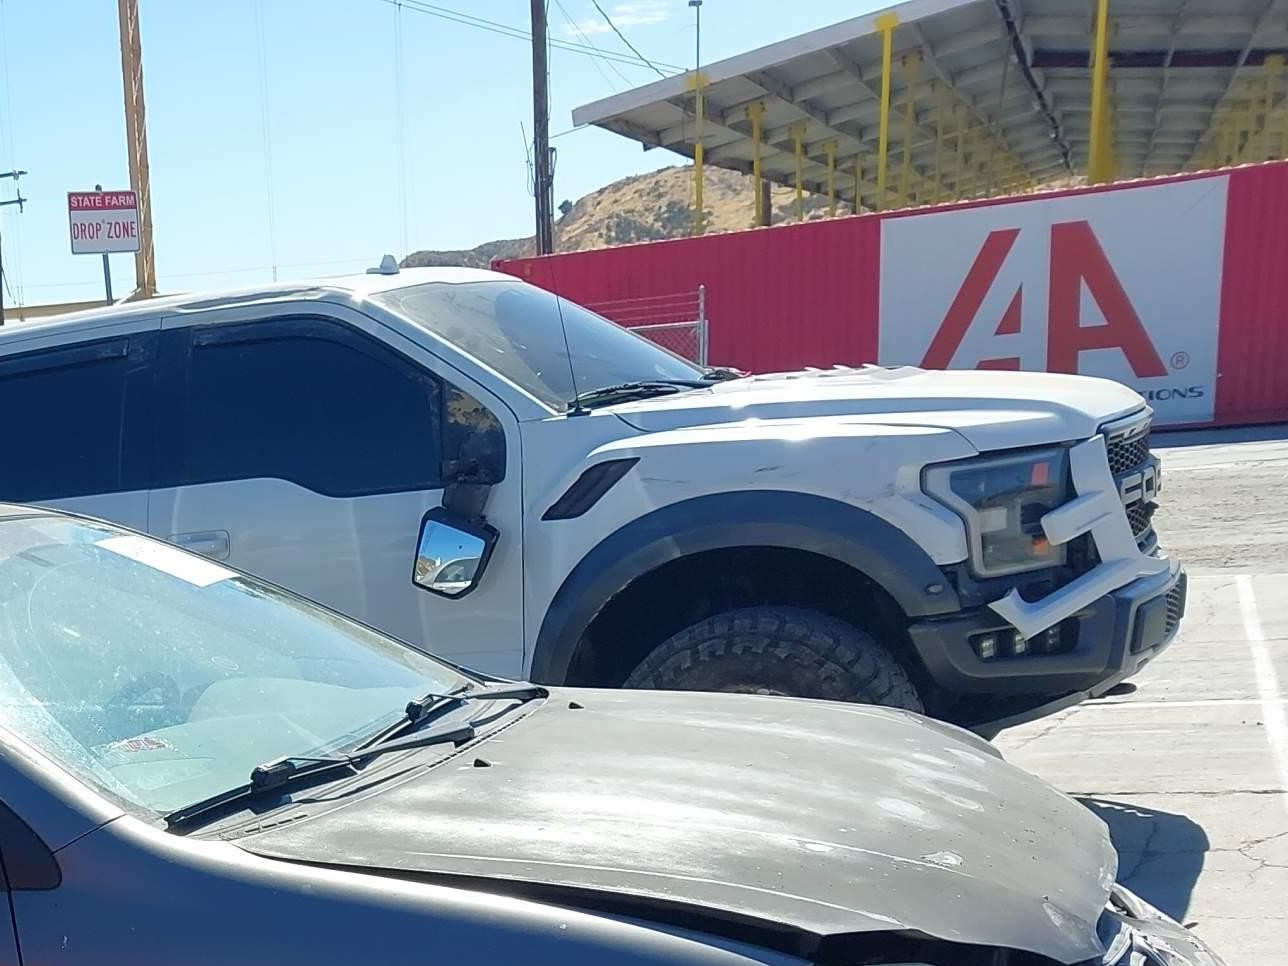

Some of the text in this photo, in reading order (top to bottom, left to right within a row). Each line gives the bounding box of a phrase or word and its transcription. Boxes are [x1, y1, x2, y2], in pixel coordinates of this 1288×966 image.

[70, 195, 135, 207] STATE FARM
[72, 221, 137, 240] DROP ZONE
